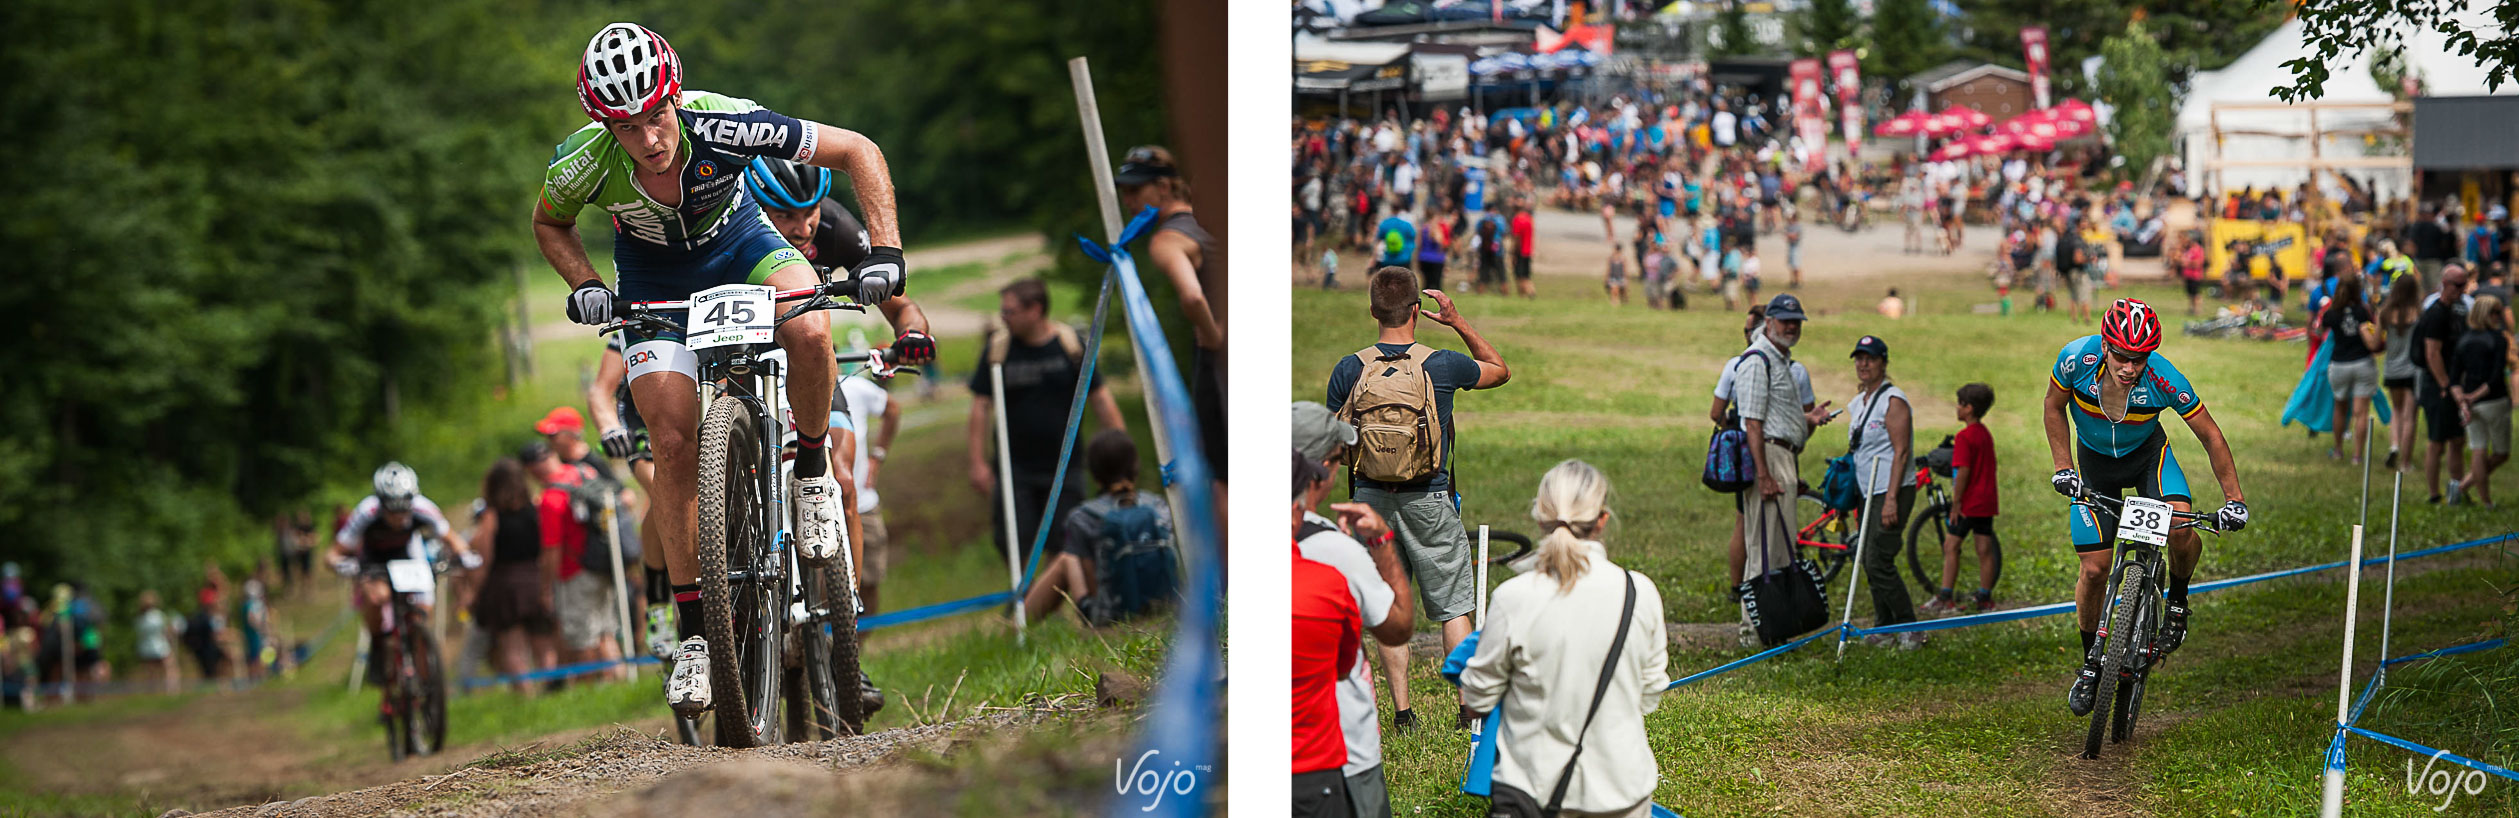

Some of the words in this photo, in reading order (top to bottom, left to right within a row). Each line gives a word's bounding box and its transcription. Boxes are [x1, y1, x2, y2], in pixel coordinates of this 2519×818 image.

[694, 118, 789, 149] KENDA
[552, 149, 595, 190] Habitat
[568, 161, 599, 191] Humanity
[703, 300, 756, 327] 45
[712, 334, 744, 343] Jeep
[629, 350, 658, 368] BQA
[1375, 444, 1397, 455] Jeep
[802, 485, 824, 496] SIDI
[2129, 508, 2161, 530] 38
[2132, 532, 2150, 541] Jeep
[1739, 581, 1761, 628] URBAN
[684, 643, 705, 653] SIDI
